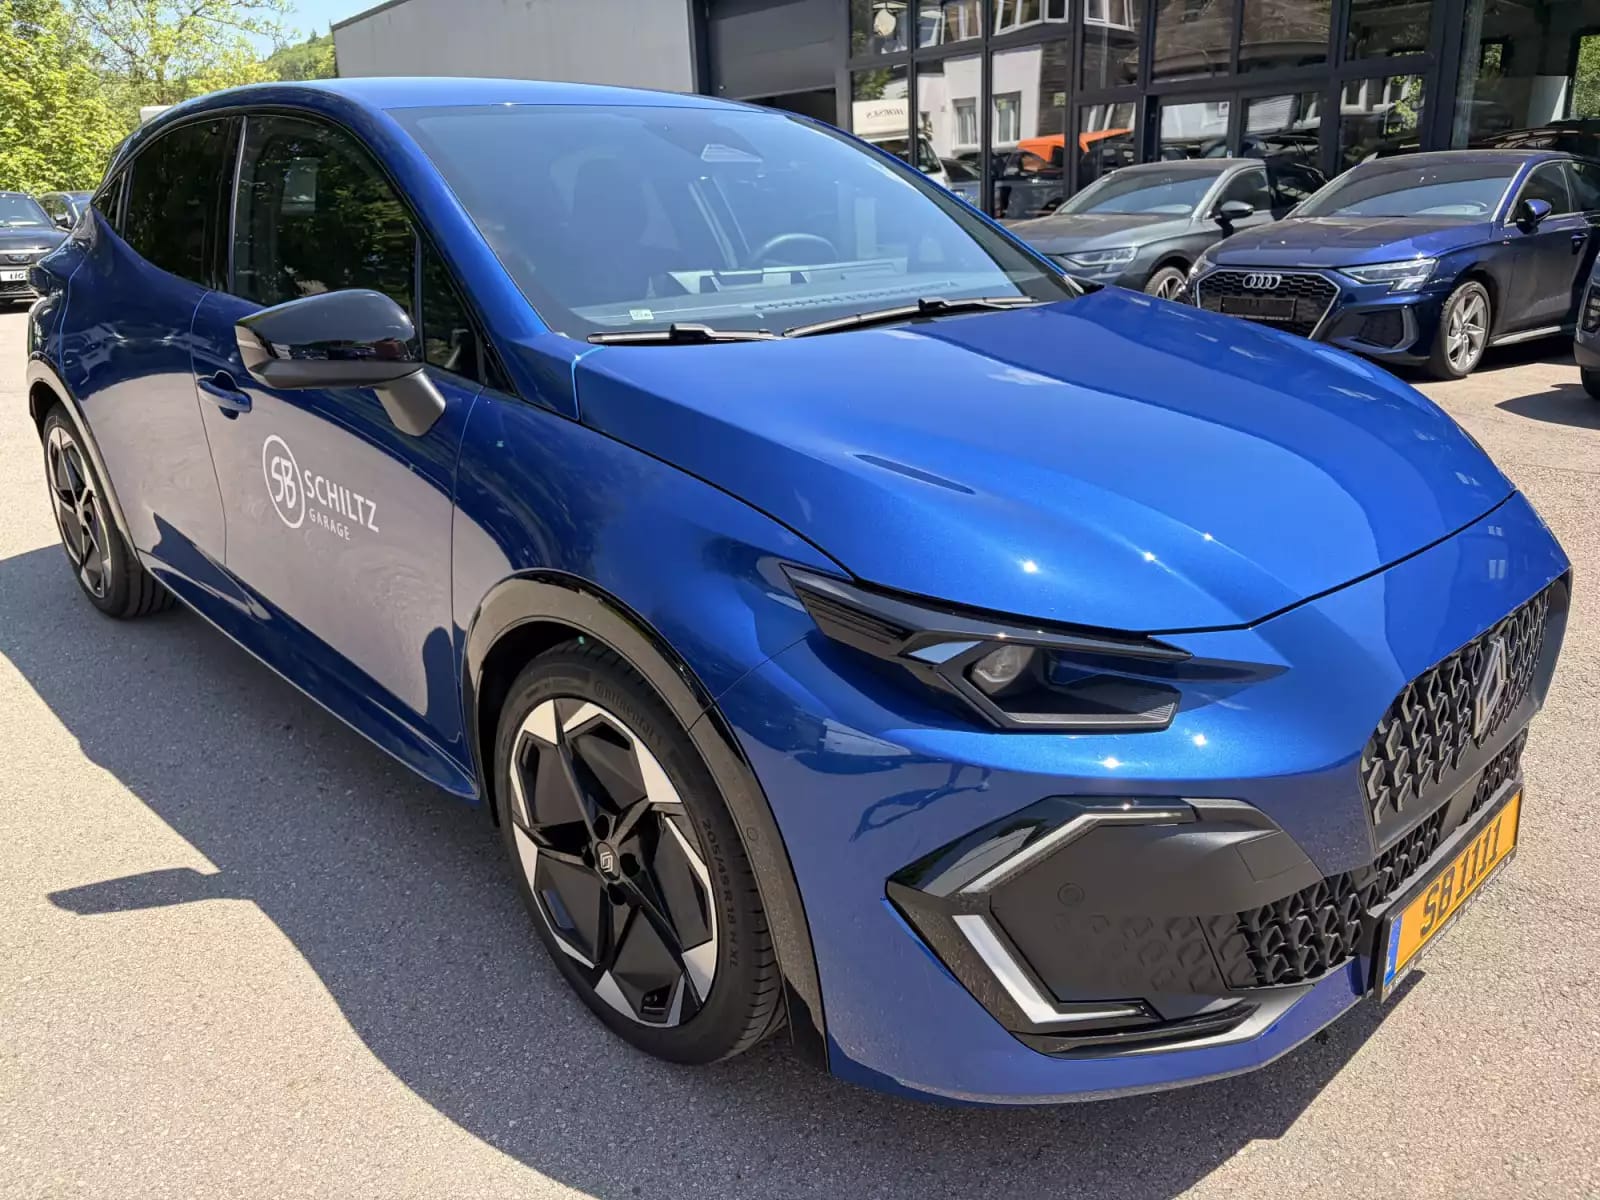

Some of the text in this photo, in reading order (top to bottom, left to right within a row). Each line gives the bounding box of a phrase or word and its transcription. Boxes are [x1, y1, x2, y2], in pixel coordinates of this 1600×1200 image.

[271, 456, 296, 508] SB
[304, 469, 379, 532] SCHILTZ
[309, 508, 351, 540] GARAGE
